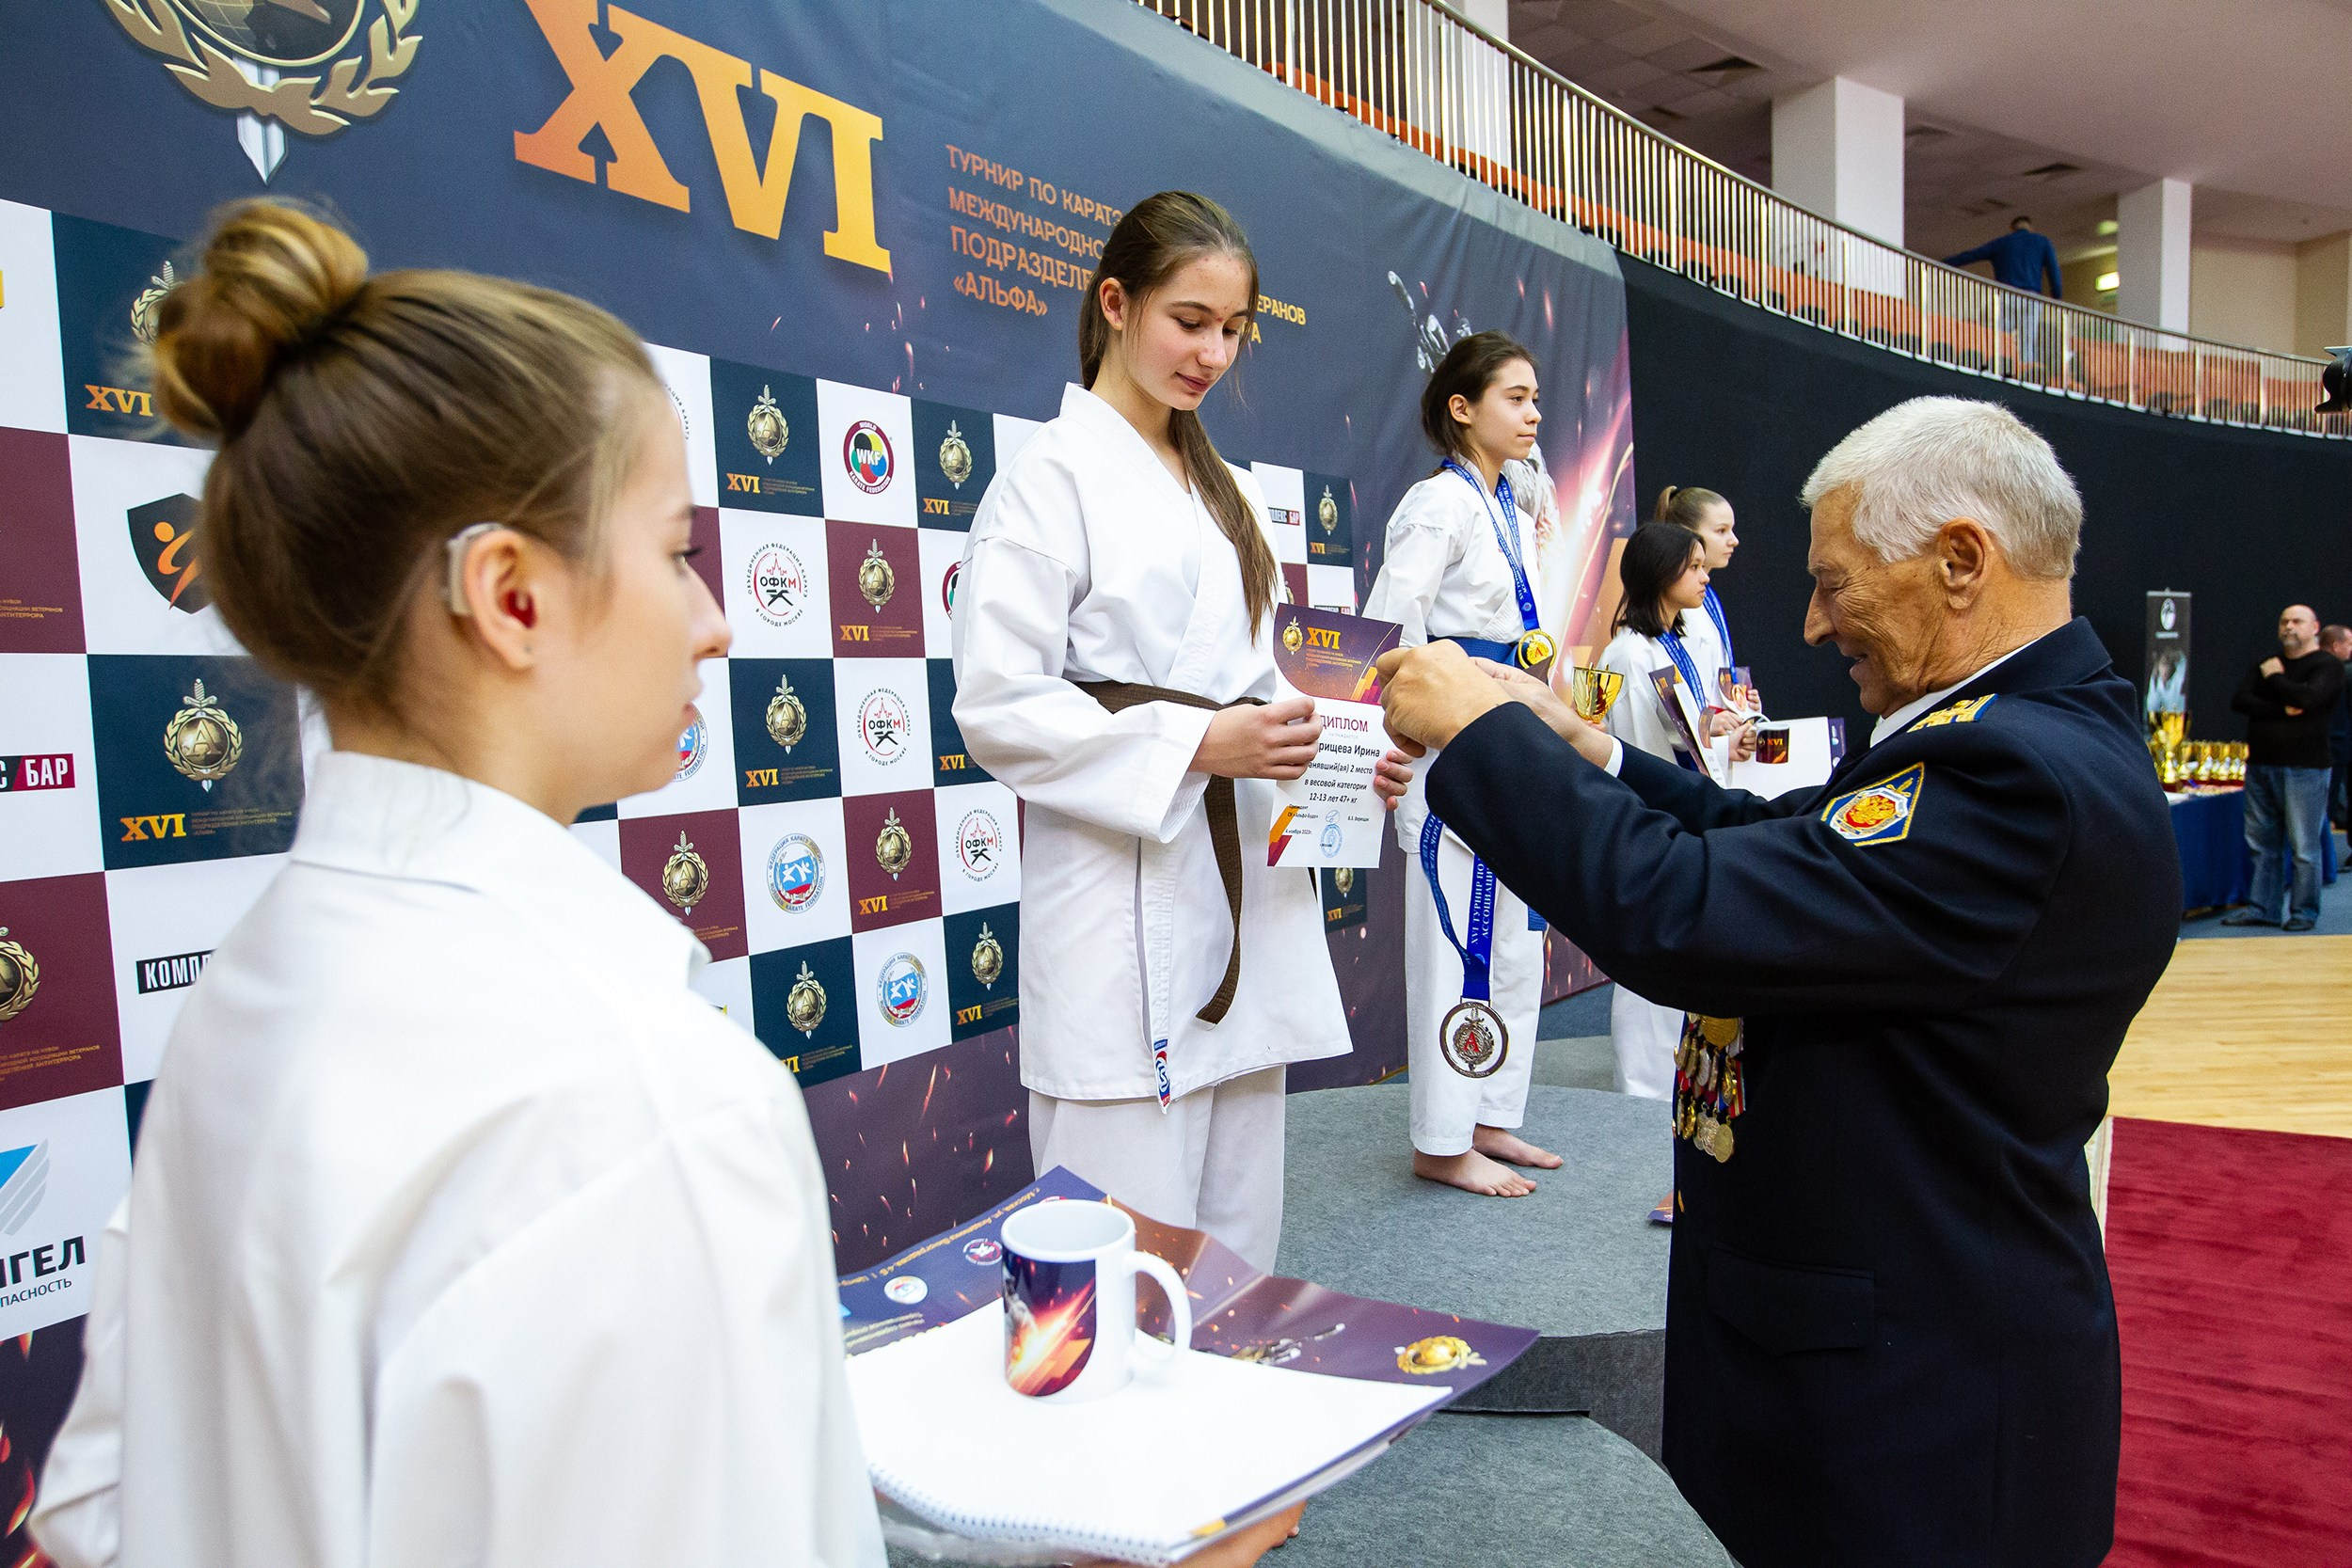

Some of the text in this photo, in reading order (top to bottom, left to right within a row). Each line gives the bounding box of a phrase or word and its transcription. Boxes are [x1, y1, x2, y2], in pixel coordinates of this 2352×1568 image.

[514, 0, 893, 274] XVI
[946, 144, 1123, 227] ТУРНИР ПО КАРАТЭ
[947, 186, 1107, 261] МЕЖДУНАРОДНО
[950, 225, 1095, 292] ПОДРАЗДЕЛЕ
[952, 271, 1048, 316] «АЛЬФА»
[1257, 293, 1306, 325] ЕРАНОВ
[85, 384, 153, 417] XVI
[856, 448, 881, 466] WKF
[726, 473, 760, 494] XVI
[923, 498, 949, 515] XVI
[1310, 542, 1326, 555] XVI
[760, 576, 797, 589] ОФКМ
[840, 625, 870, 641] XVI
[1306, 626, 1342, 650] XVI
[868, 719, 900, 730] ОФКМ
[1320, 715, 1369, 733] ДИПЛОМ
[684, 743, 706, 778] FEDERATION
[1318, 742, 1380, 758] рищева Ирина
[24, 757, 69, 787] БАР
[939, 754, 965, 771] XVI
[1308, 761, 1374, 775] анявший(ая) 2 место
[745, 768, 779, 788] XVI
[1310, 779, 1337, 788] весовой
[1336, 782, 1368, 792] категории
[1309, 792, 1327, 802] 12-13
[1339, 795, 1351, 803] 47+
[120, 813, 186, 842] XVI
[965, 836, 993, 849] ОФКМ
[769, 838, 789, 870] ФЕДЕРАЦИЯ
[805, 876, 823, 909] FEDERATION
[1473, 863, 1485, 923] ТУРНИР ПО
[859, 895, 889, 916] XVI
[1327, 908, 1343, 922] XVI
[957, 1005, 983, 1025] XVI
[0, 1235, 86, 1289] ГЕЛ
[0, 1278, 72, 1307] ПАСНОСТЬ
